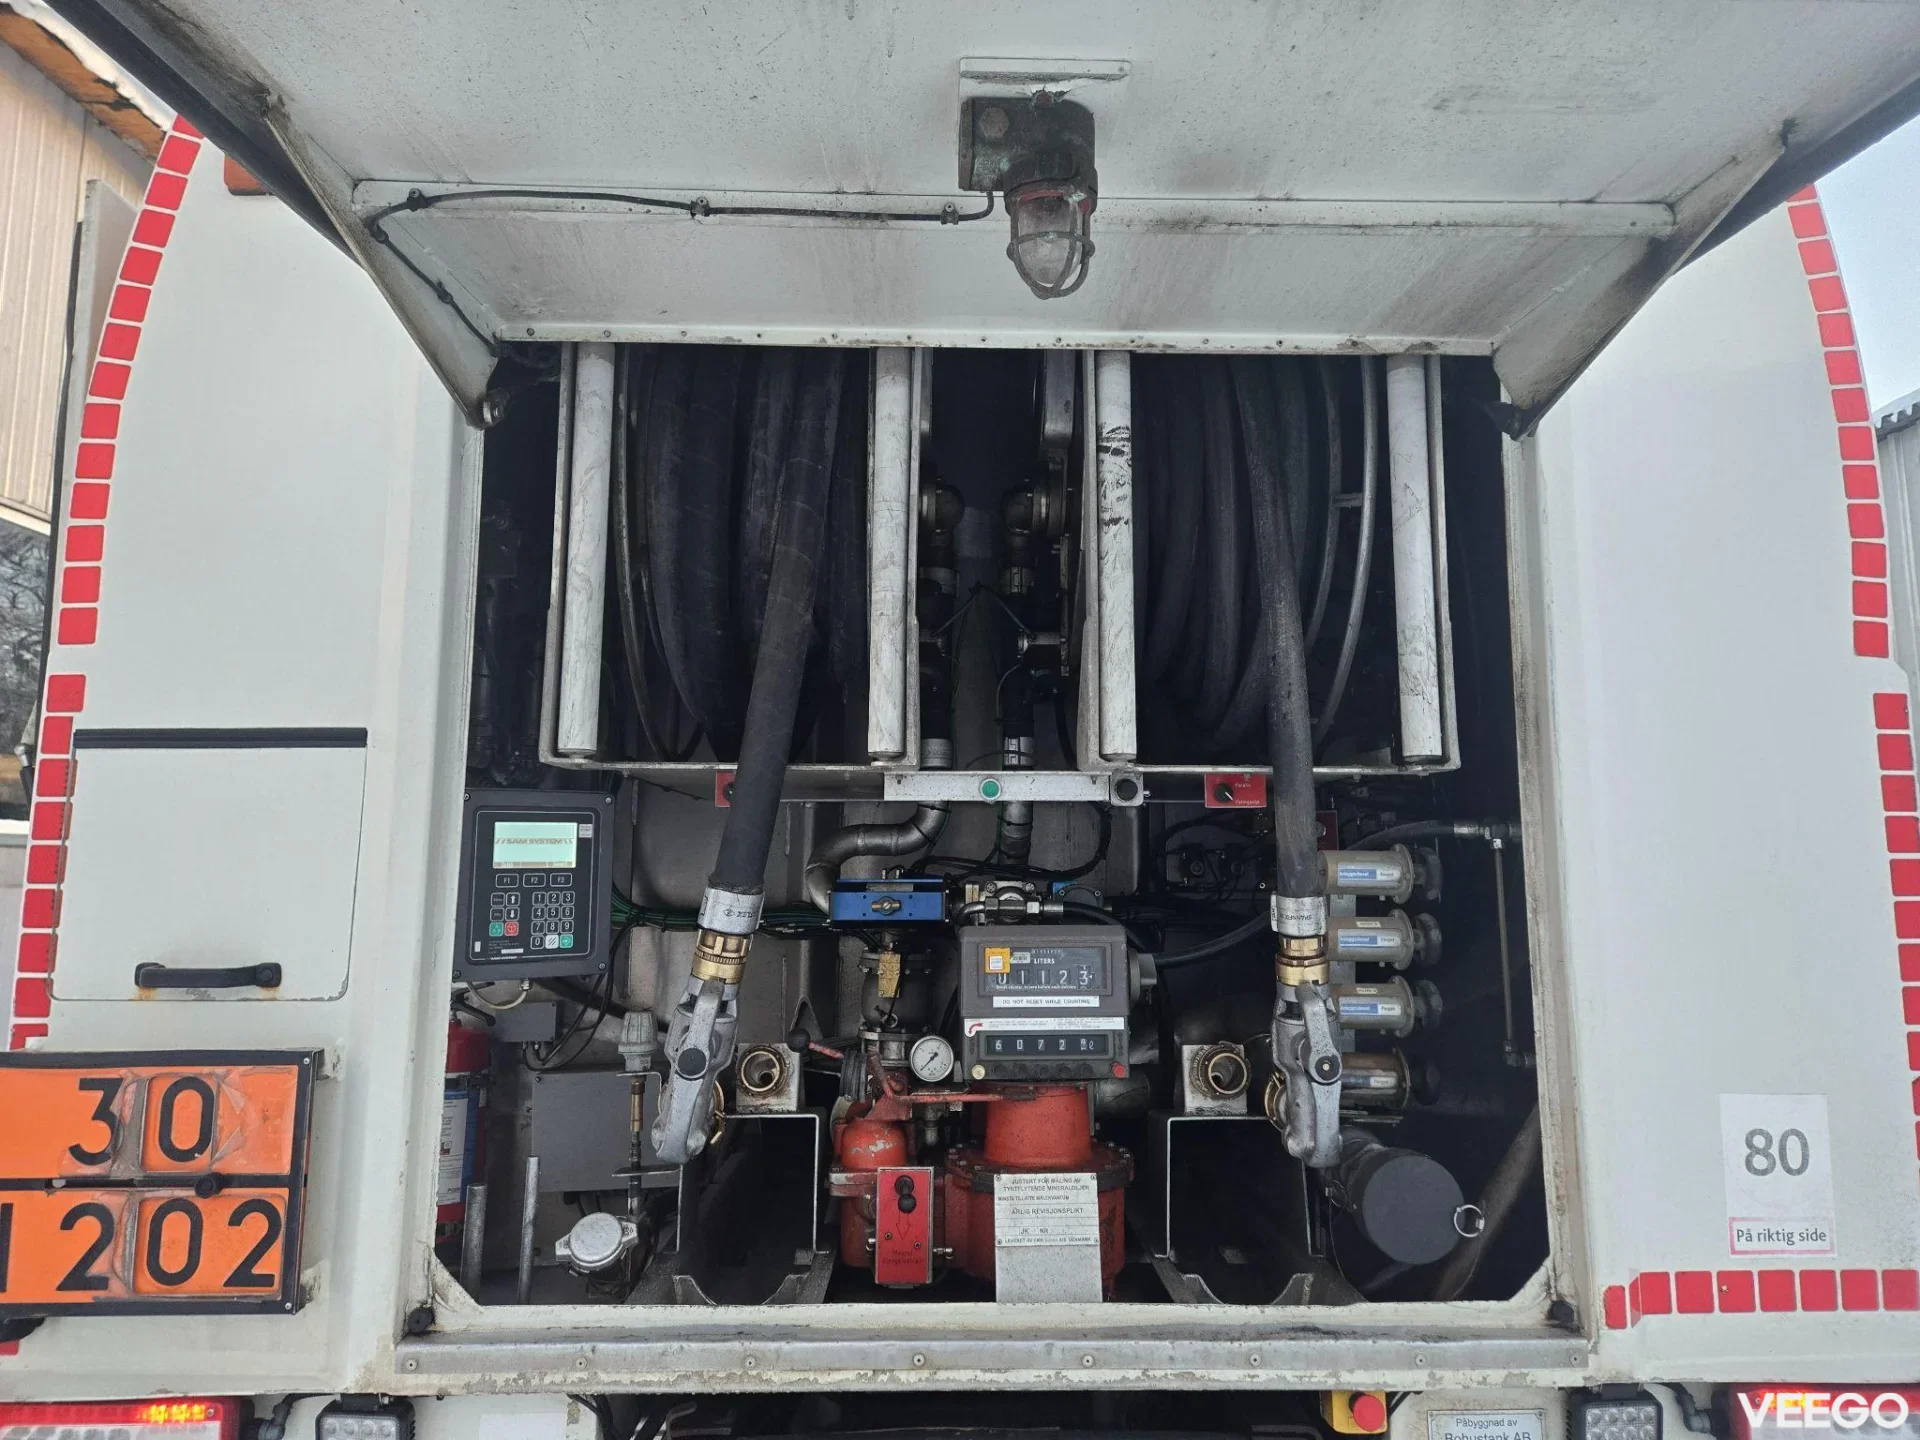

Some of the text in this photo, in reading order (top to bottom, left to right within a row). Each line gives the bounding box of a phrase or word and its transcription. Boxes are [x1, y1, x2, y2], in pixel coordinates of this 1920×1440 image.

[503, 876, 511, 884] F1
[530, 876, 539, 884] F2
[557, 875, 565, 884] F3
[68, 1075, 216, 1166] 30
[1744, 1128, 1810, 1177] 80
[1031, 1207, 1084, 1215] REVISJONSPLIKT
[1736, 1228, 1827, 1246] På riktig side
[1456, 1418, 1518, 1430] Påbyggnad av
